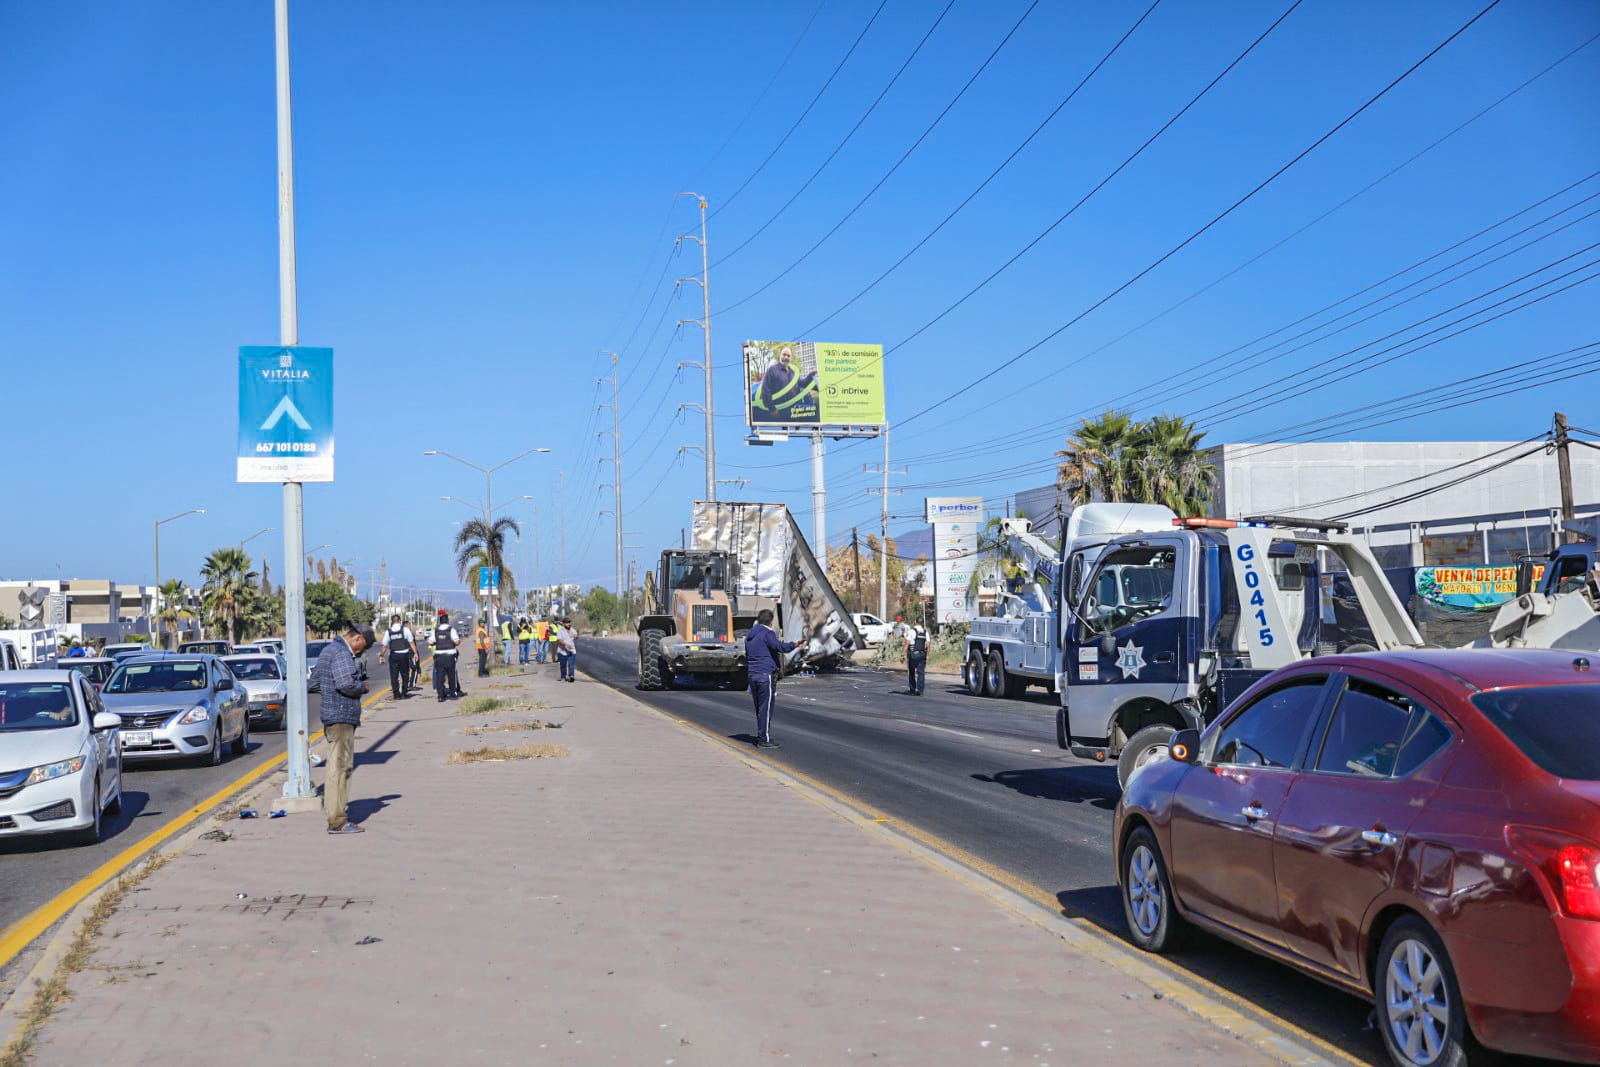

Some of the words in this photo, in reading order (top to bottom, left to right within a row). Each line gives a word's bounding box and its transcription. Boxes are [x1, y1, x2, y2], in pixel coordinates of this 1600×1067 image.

[262, 369, 310, 378] VITALIA
[841, 386, 869, 395] inDrive
[256, 442, 274, 453] 667
[276, 442, 291, 453] 101
[939, 503, 979, 513] perber
[1435, 568, 1473, 583] VENTA
[1475, 568, 1491, 582] DE
[1485, 583, 1491, 593] Y
[1237, 544, 1274, 647] G-0415
